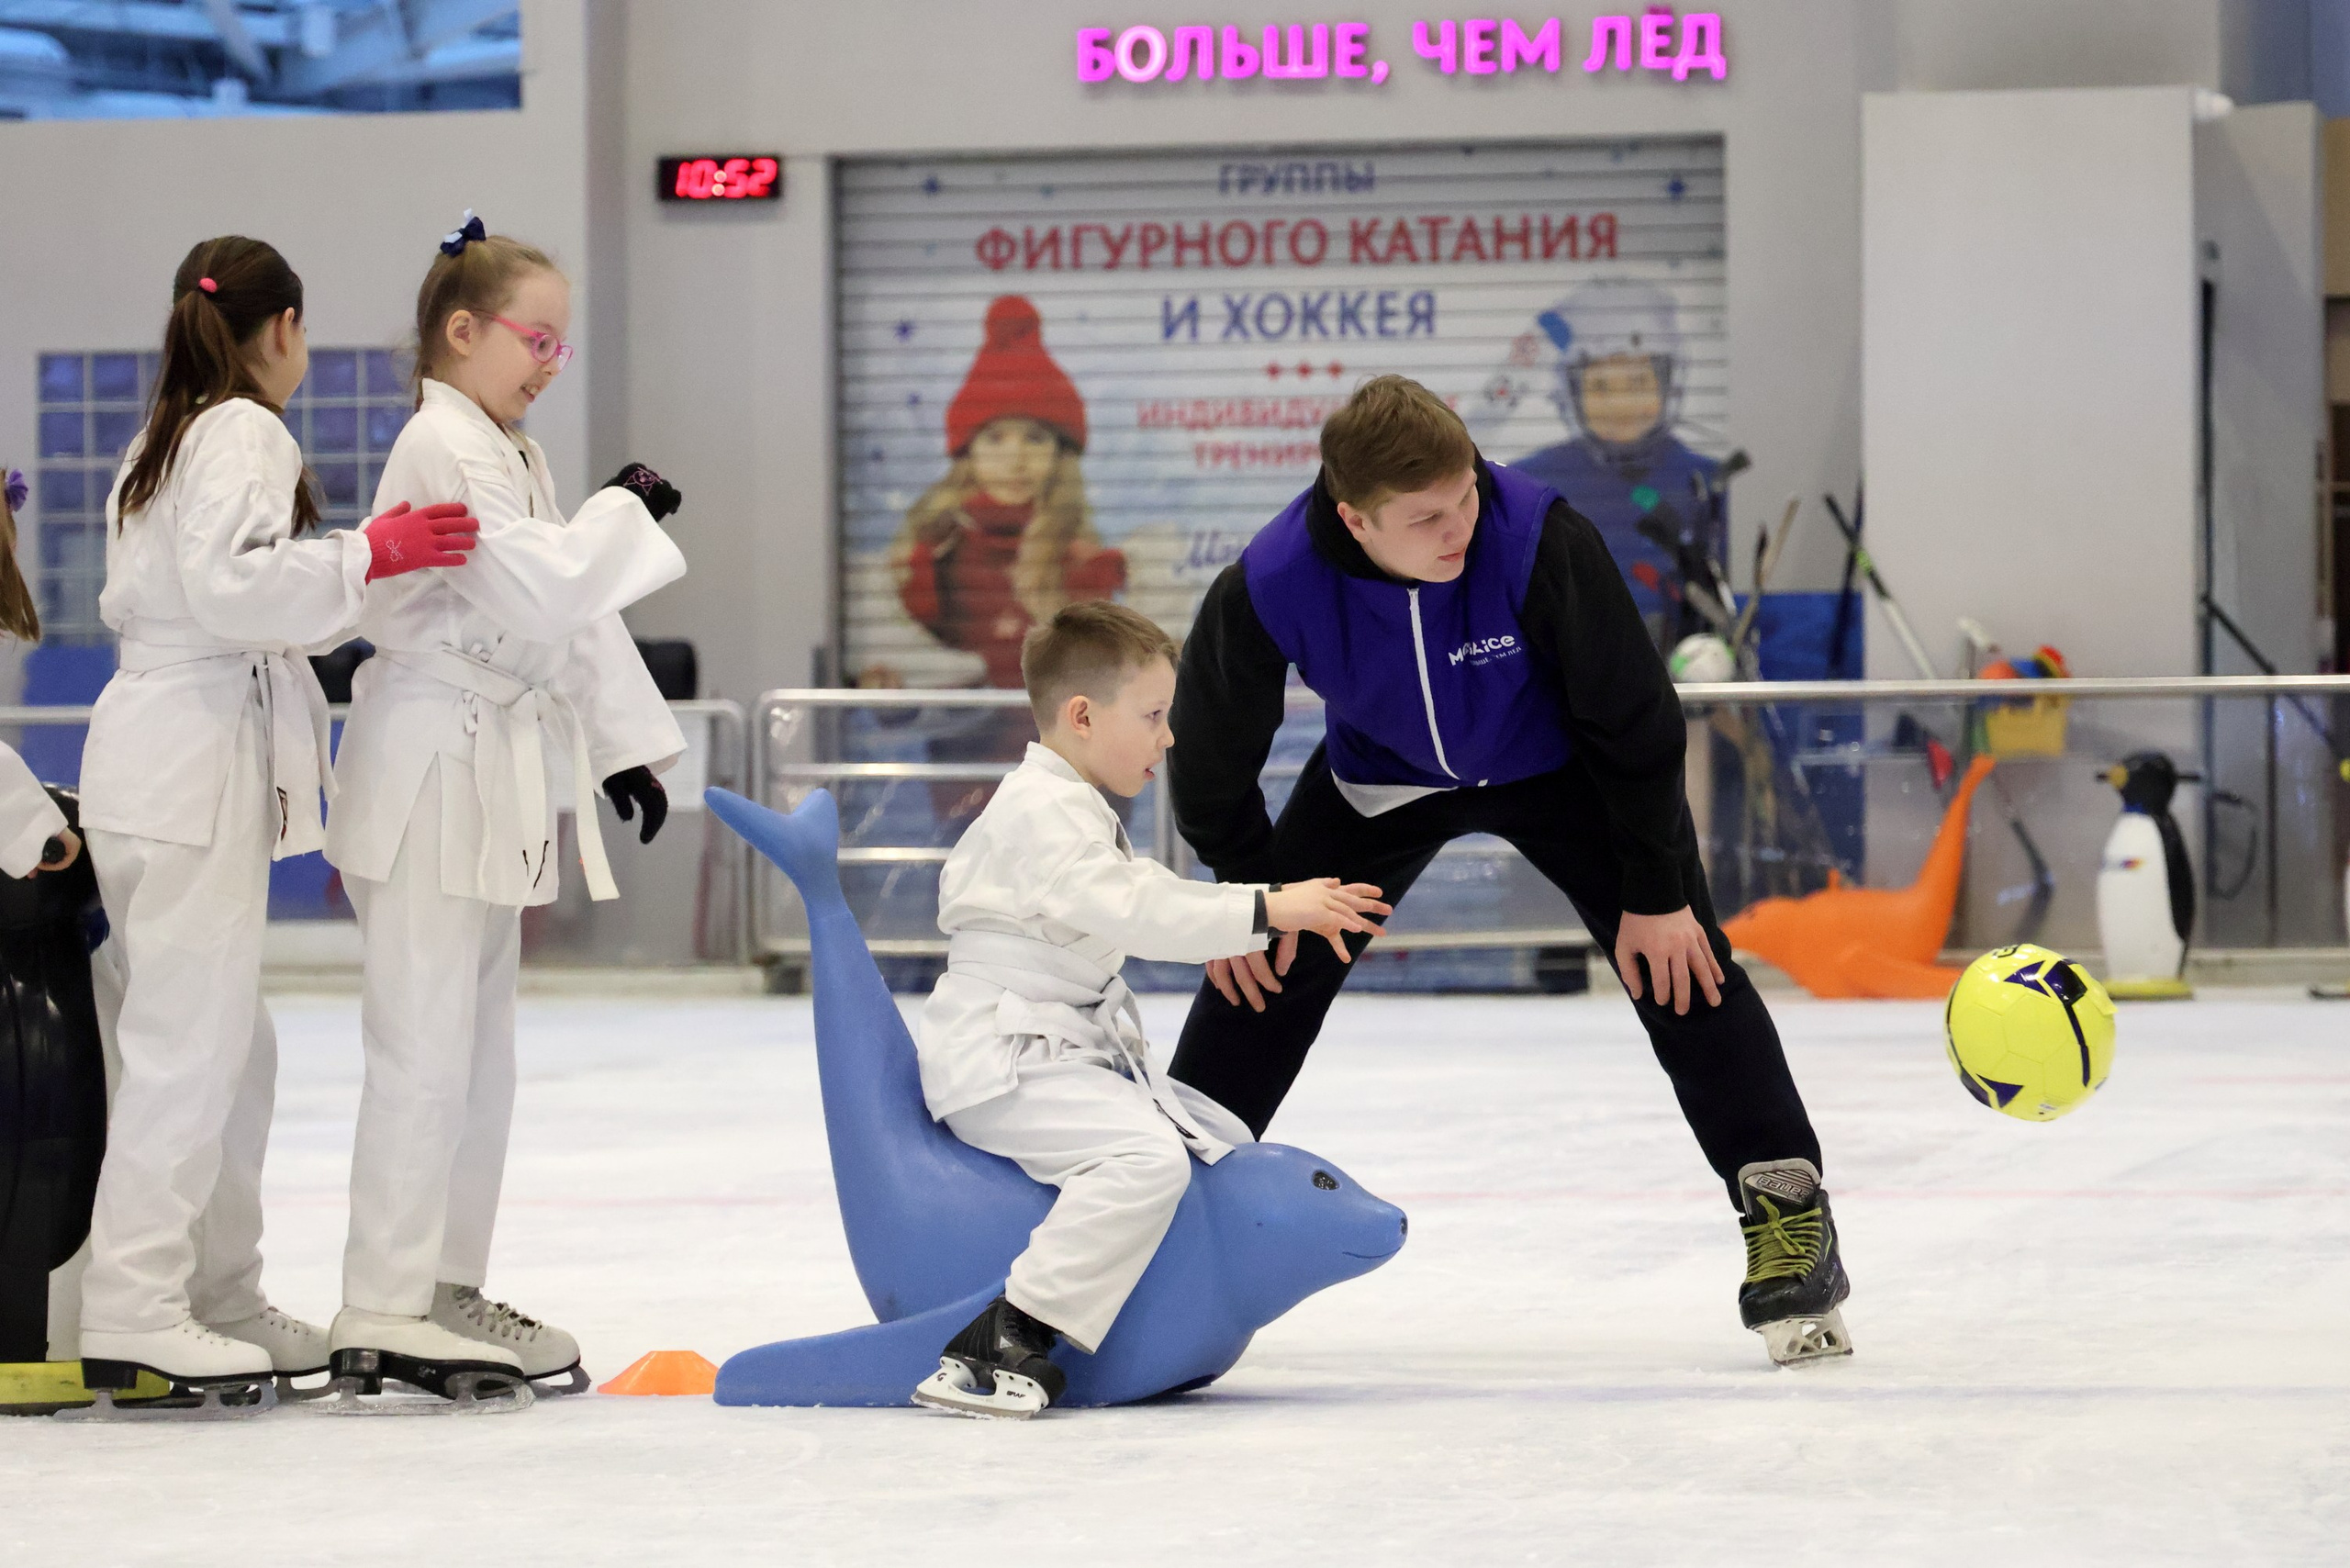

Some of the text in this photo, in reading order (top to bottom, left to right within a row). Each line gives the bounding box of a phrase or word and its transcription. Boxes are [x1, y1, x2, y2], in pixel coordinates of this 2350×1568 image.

[1077, 4, 1727, 84] БОЛЬШЕ, ЧЕМ ЛЁД
[676, 158, 778, 199] 10:52
[1219, 162, 1374, 195] ГРУППЫ
[975, 213, 1618, 271] ФИГУРНОГО КАТАНИЯ
[1162, 290, 1437, 342] И ХОККЕЯ
